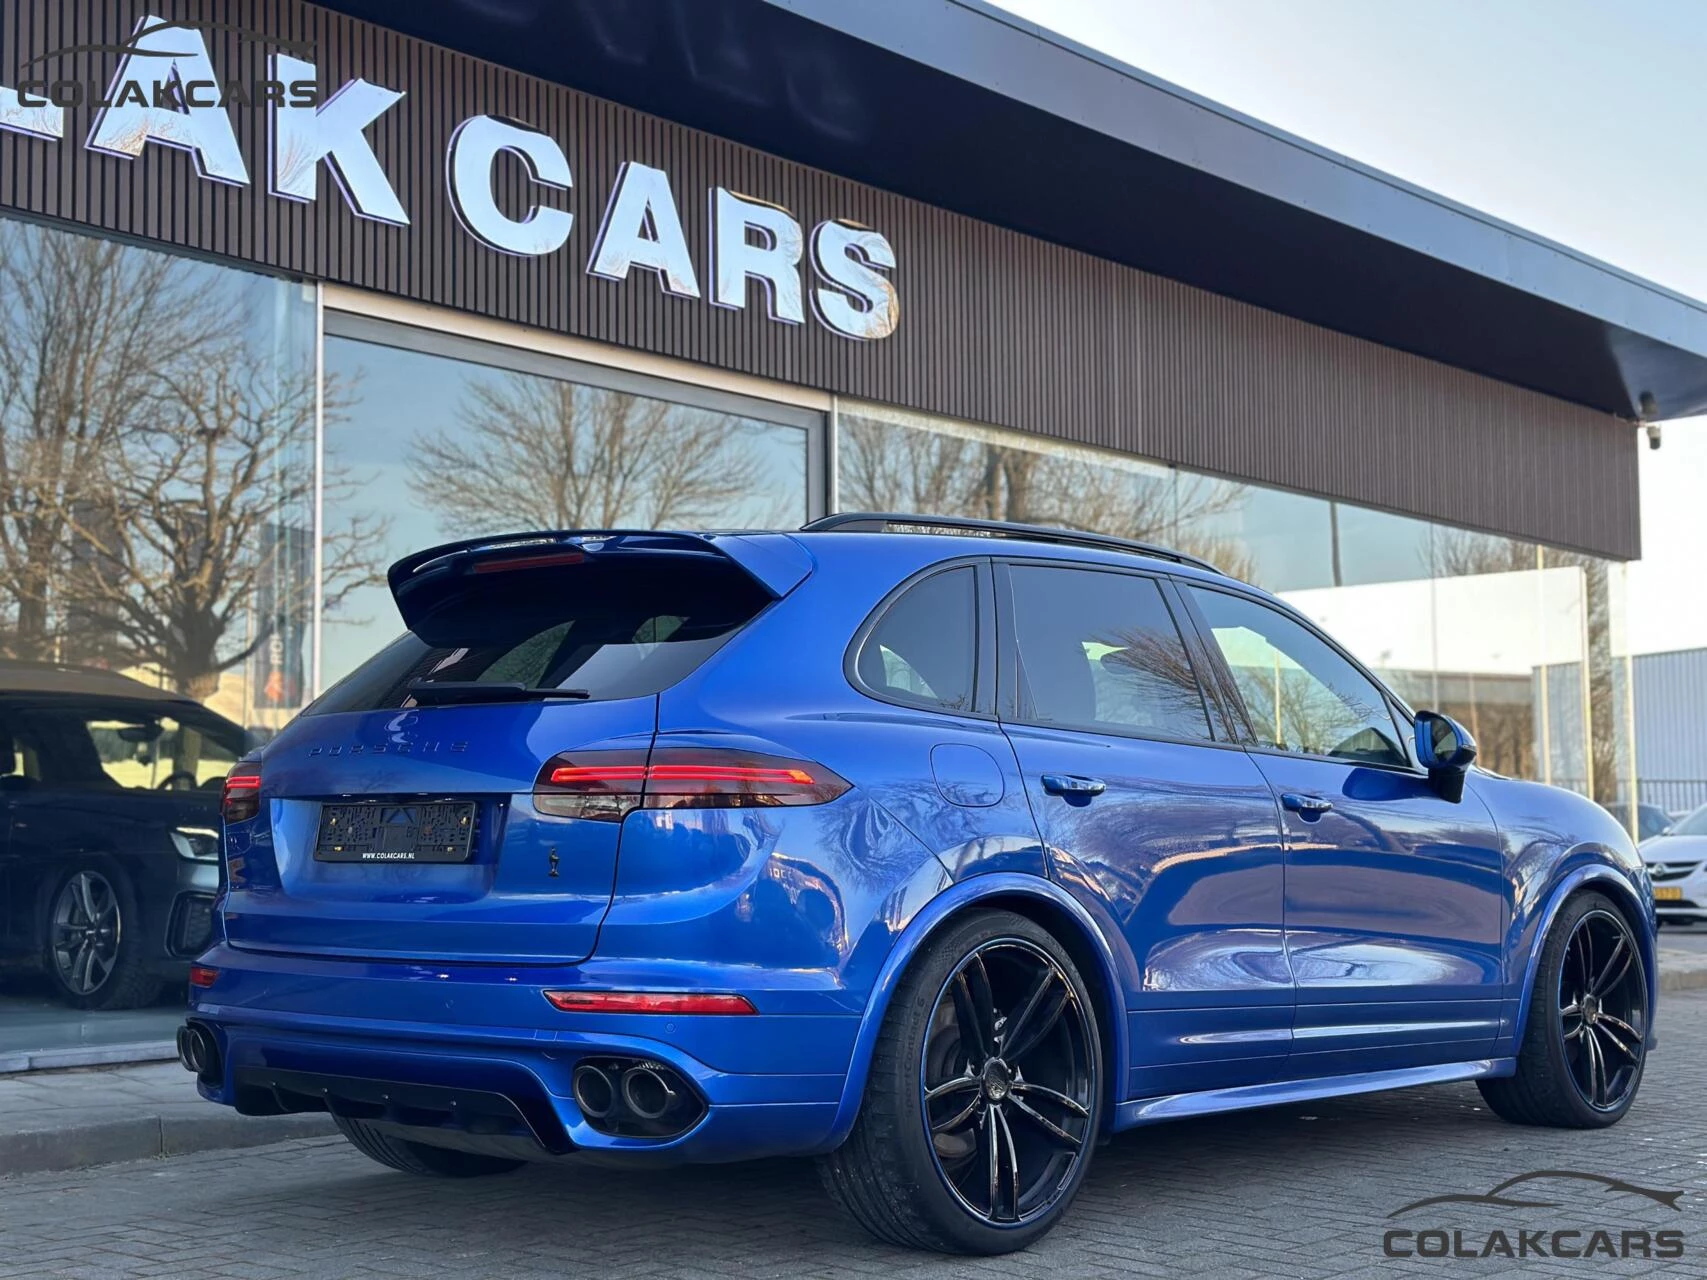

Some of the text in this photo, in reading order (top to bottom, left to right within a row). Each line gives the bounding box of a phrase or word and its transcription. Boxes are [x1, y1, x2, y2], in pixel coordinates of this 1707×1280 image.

[0, 14, 900, 341] AK CARS
[362, 852, 415, 860] WWW.COLAKCARS.NL
